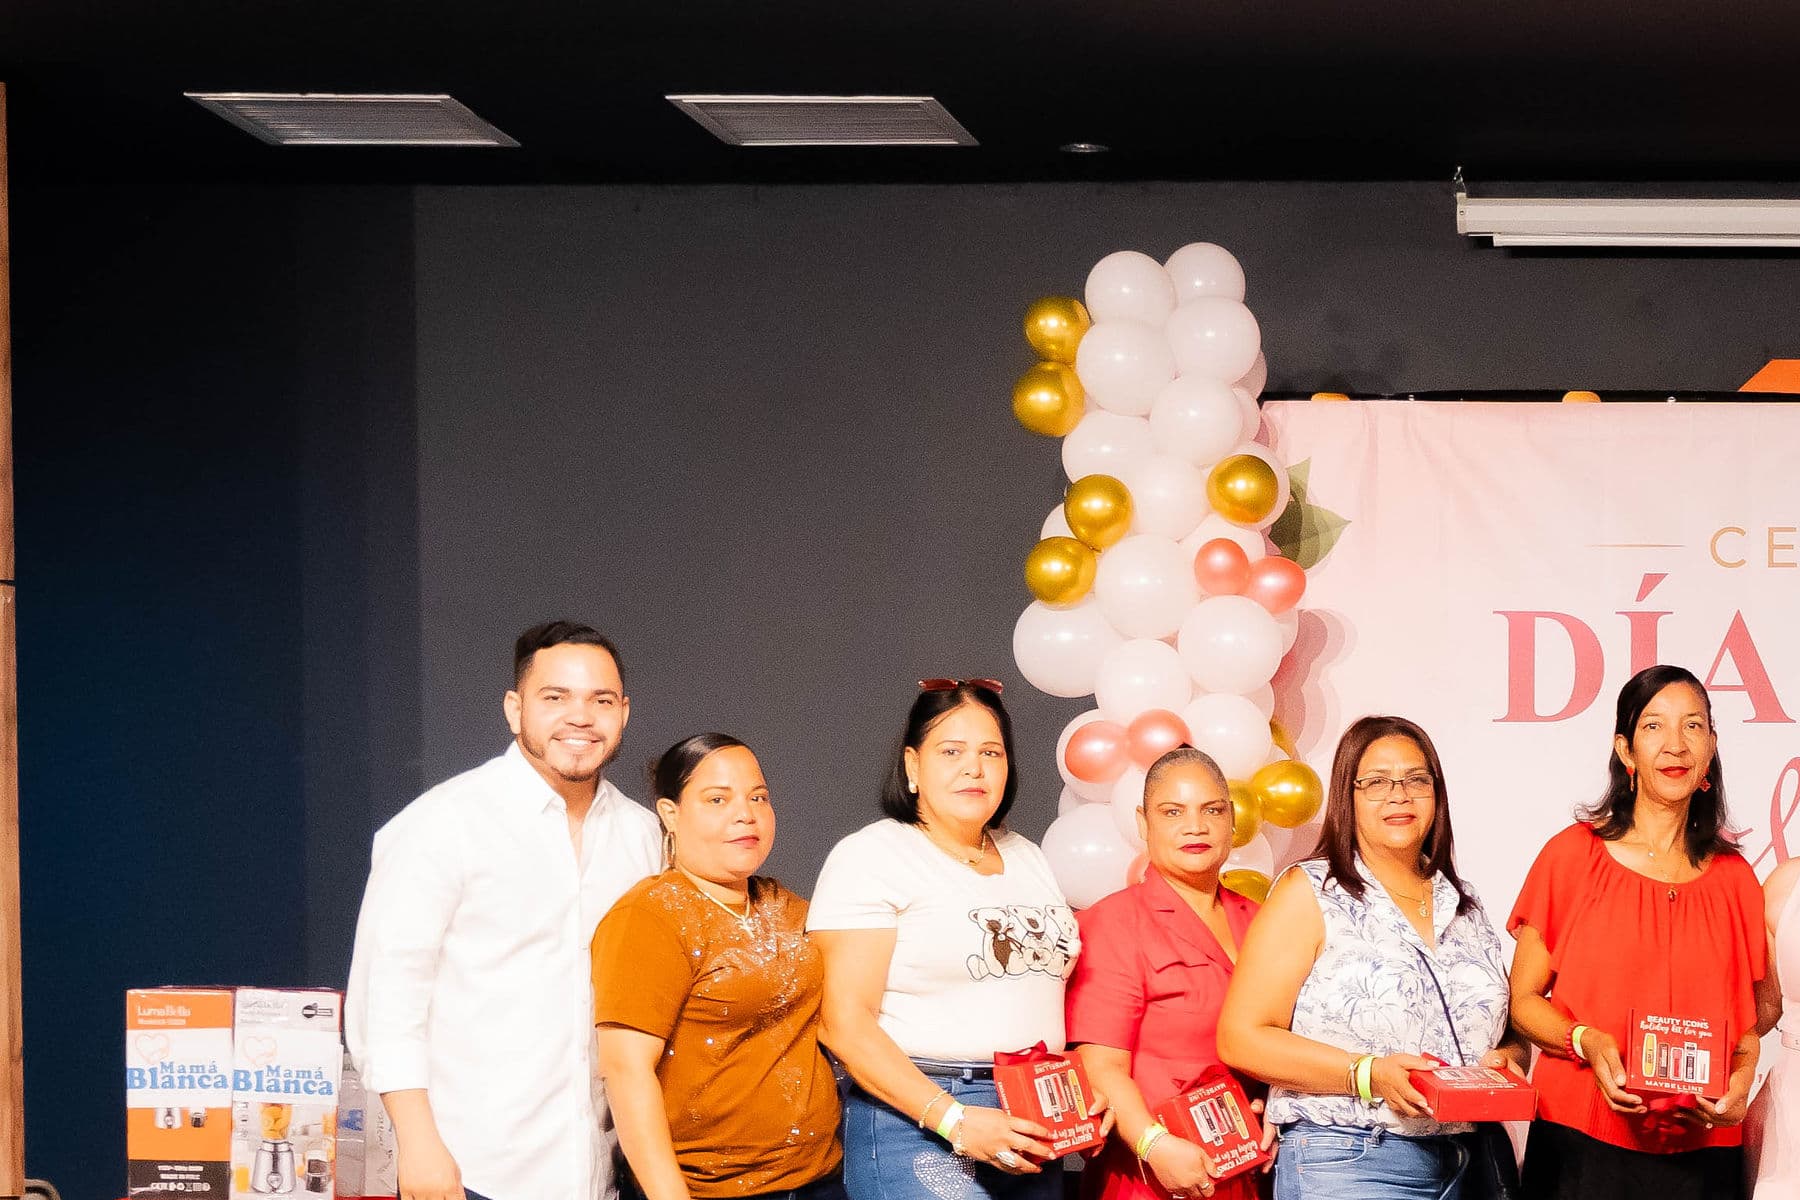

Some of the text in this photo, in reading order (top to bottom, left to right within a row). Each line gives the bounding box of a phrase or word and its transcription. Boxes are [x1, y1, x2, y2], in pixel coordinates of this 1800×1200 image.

[1493, 573, 1795, 724] DÍA
[1647, 1015, 1680, 1026] BEAUTY
[160, 1062, 218, 1074] Mamá
[266, 1065, 323, 1079] Mamá
[127, 1067, 228, 1089] Blanca
[232, 1069, 333, 1095] Blanca
[1645, 1080, 1704, 1093] MAYBELLINE
